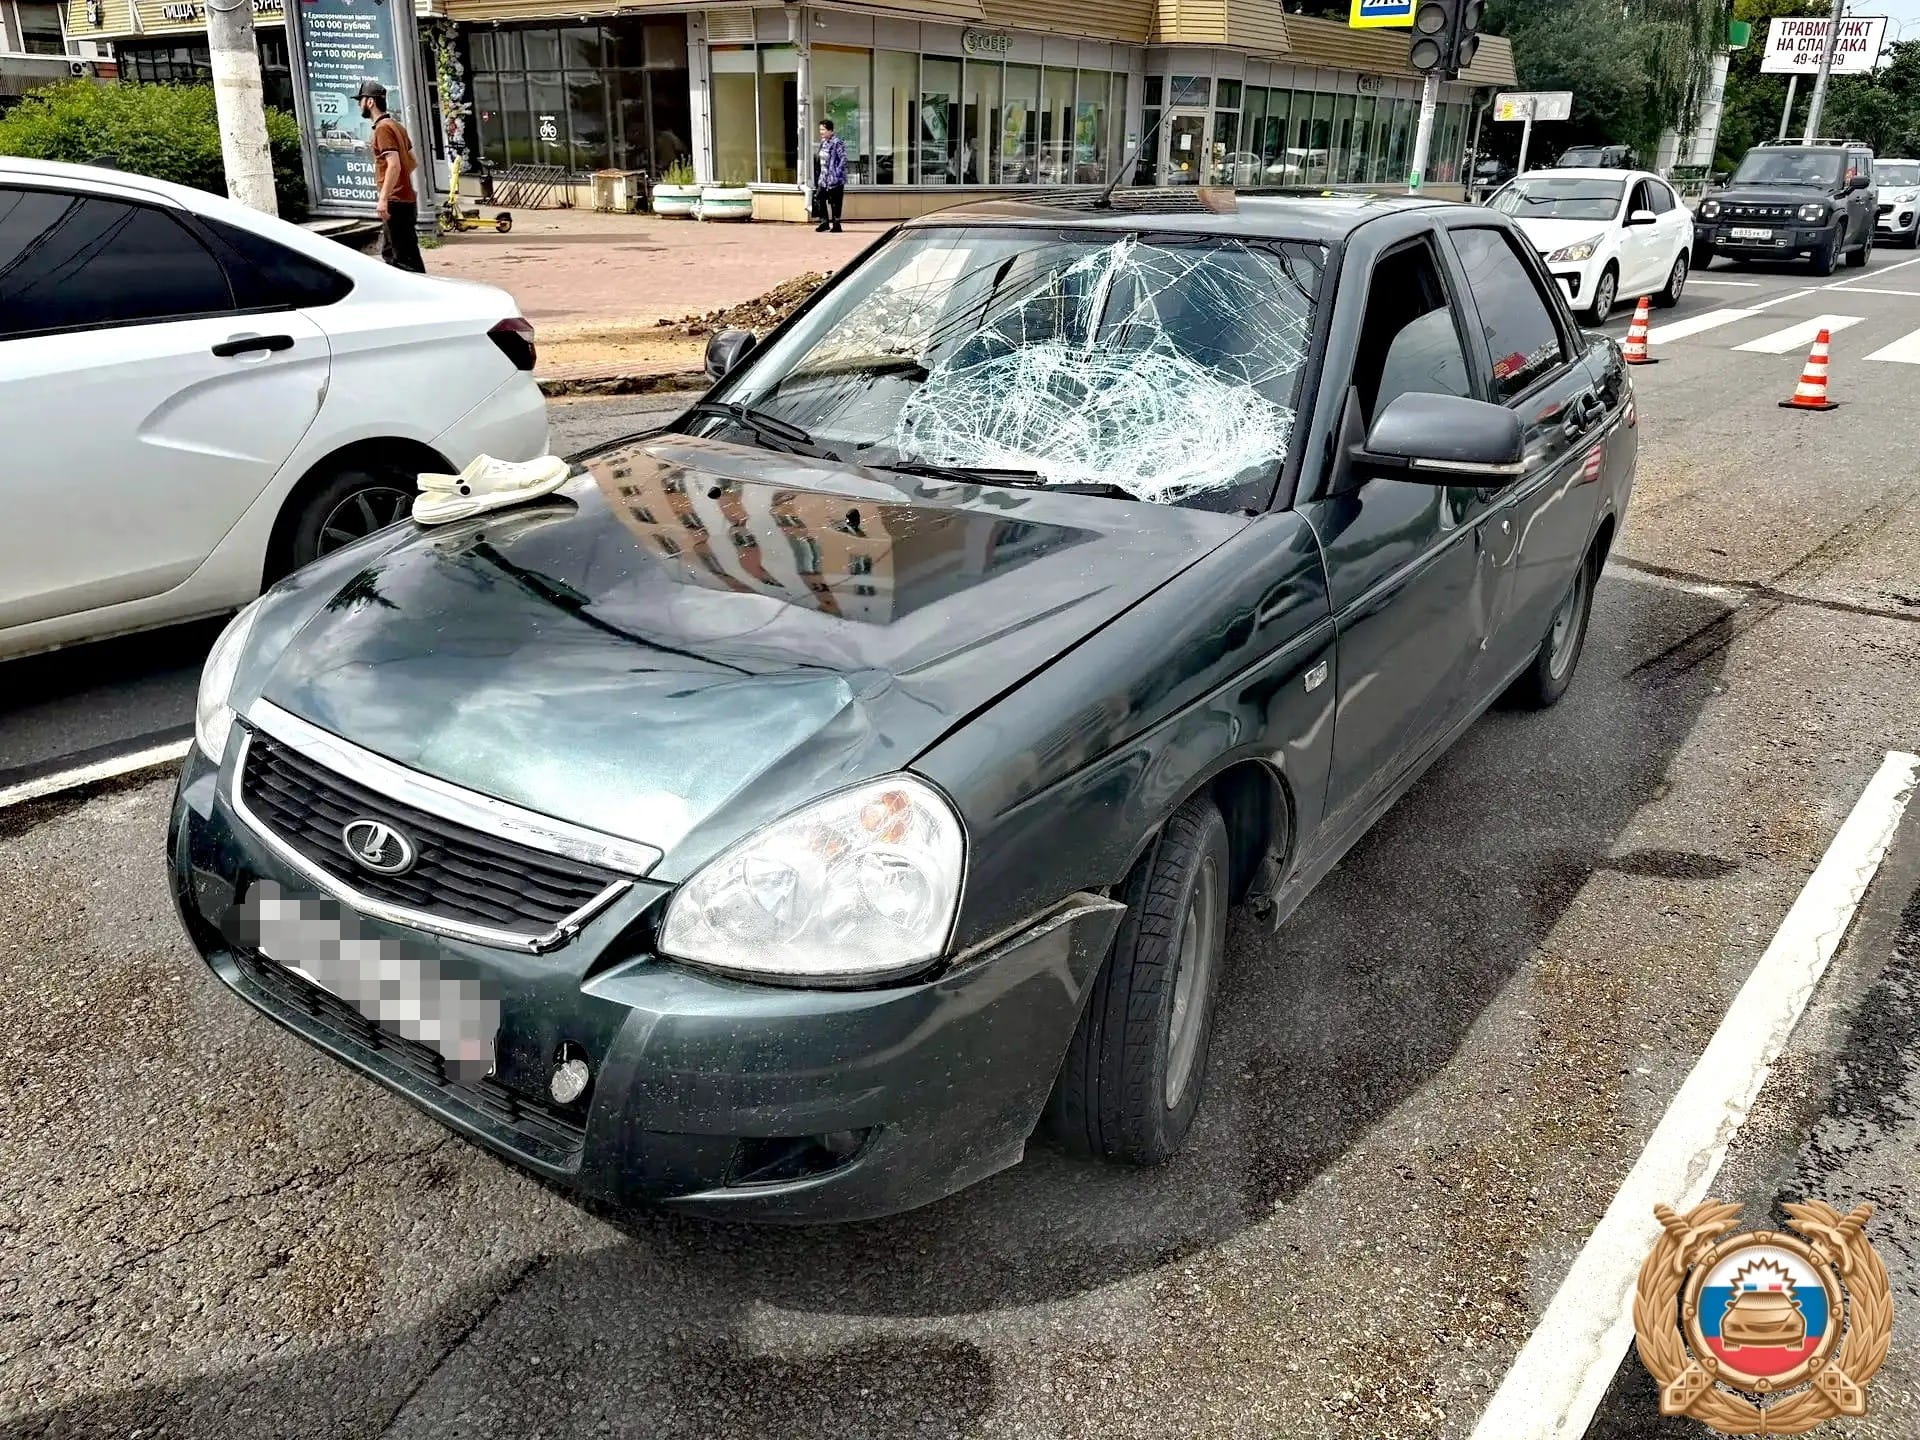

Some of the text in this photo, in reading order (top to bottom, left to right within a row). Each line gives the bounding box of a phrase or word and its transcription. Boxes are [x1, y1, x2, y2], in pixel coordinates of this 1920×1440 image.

[162, 3, 195, 20] ПИЦЦА
[309, 20, 371, 31] 100 000 рублей
[1781, 21, 1874, 37] ТРАВМУНКТ
[1776, 38, 1867, 52] НА СПАТАКА
[324, 50, 340, 58] 100
[341, 50, 356, 58] 000
[357, 51, 384, 60] рублей
[316, 103, 339, 114] 122
[346, 162, 376, 173] ВСТА
[336, 174, 353, 185] НА
[327, 188, 380, 199] ТВЕРСКОГ
[1723, 207, 1793, 216] JETOUR
